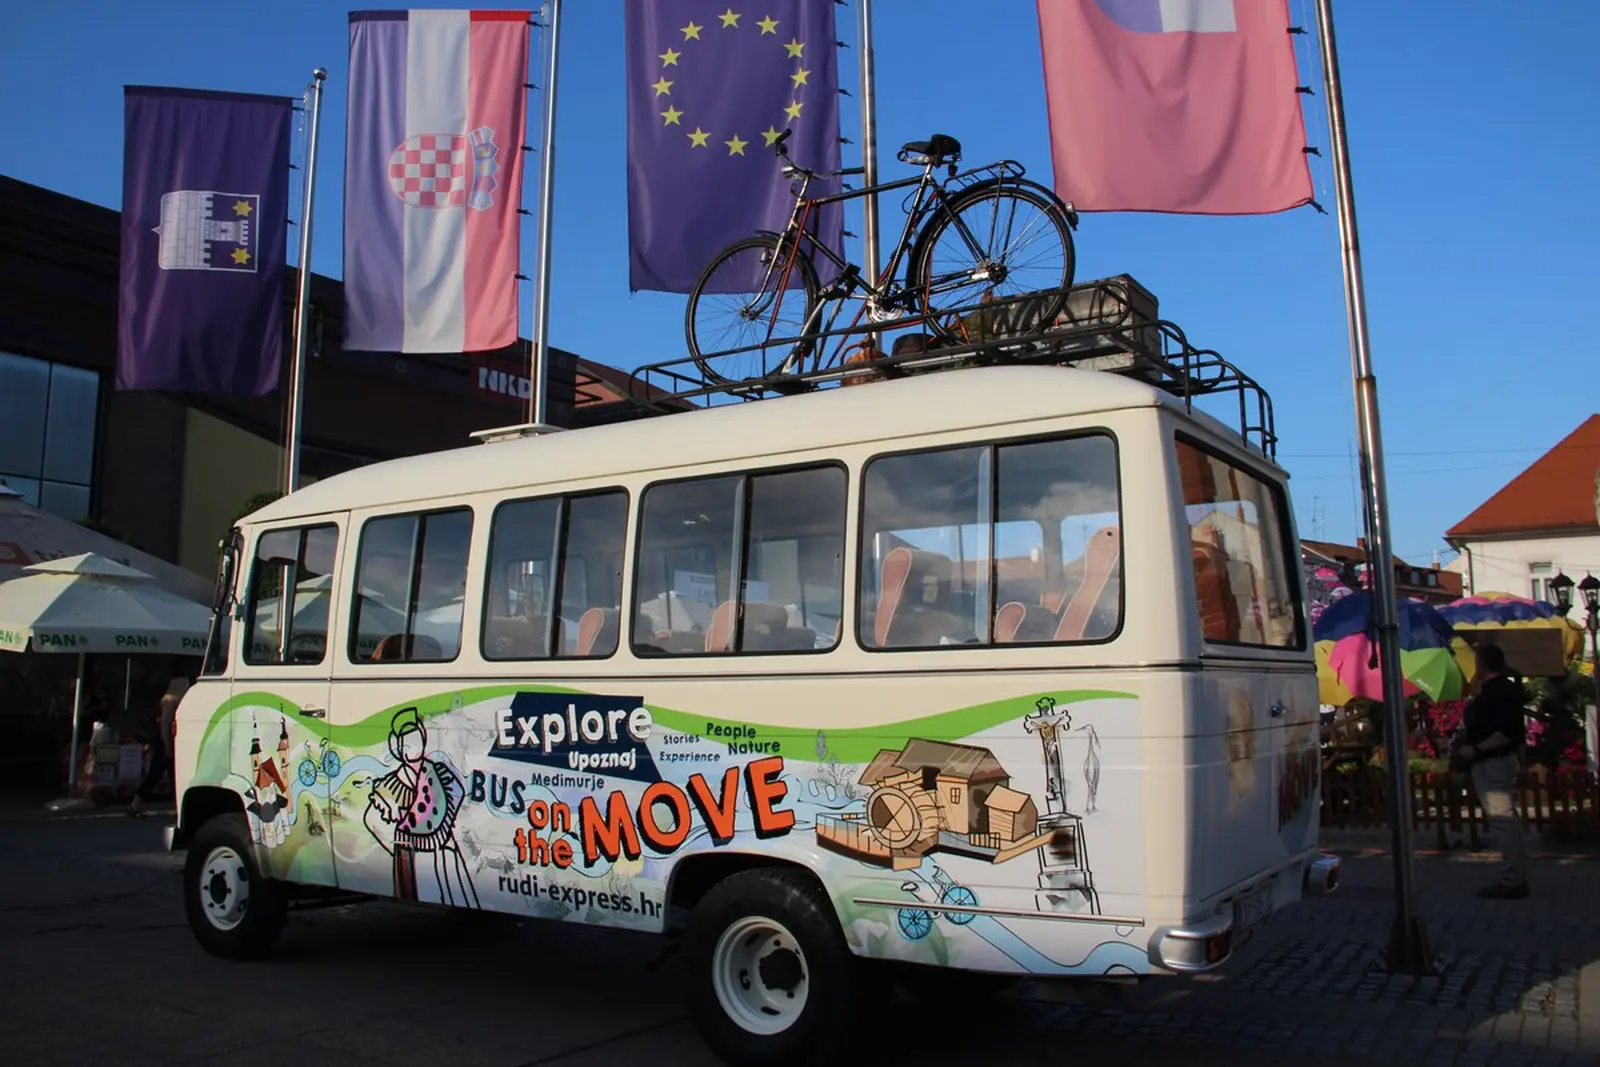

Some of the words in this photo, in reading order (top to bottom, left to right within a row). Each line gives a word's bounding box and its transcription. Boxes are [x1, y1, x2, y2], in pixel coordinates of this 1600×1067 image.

[40, 633, 77, 647] PAN
[116, 634, 148, 647] PAN
[496, 704, 653, 752] Explore
[663, 734, 700, 745] Stories
[706, 722, 756, 739] People
[568, 747, 637, 771] Upoznaj
[659, 751, 721, 763] Experience
[728, 740, 781, 756] Nature
[470, 769, 526, 814] BUS
[527, 799, 571, 831] on
[579, 756, 795, 868] MOVE
[513, 827, 573, 868] the
[498, 874, 663, 919] rudi-express.hr
